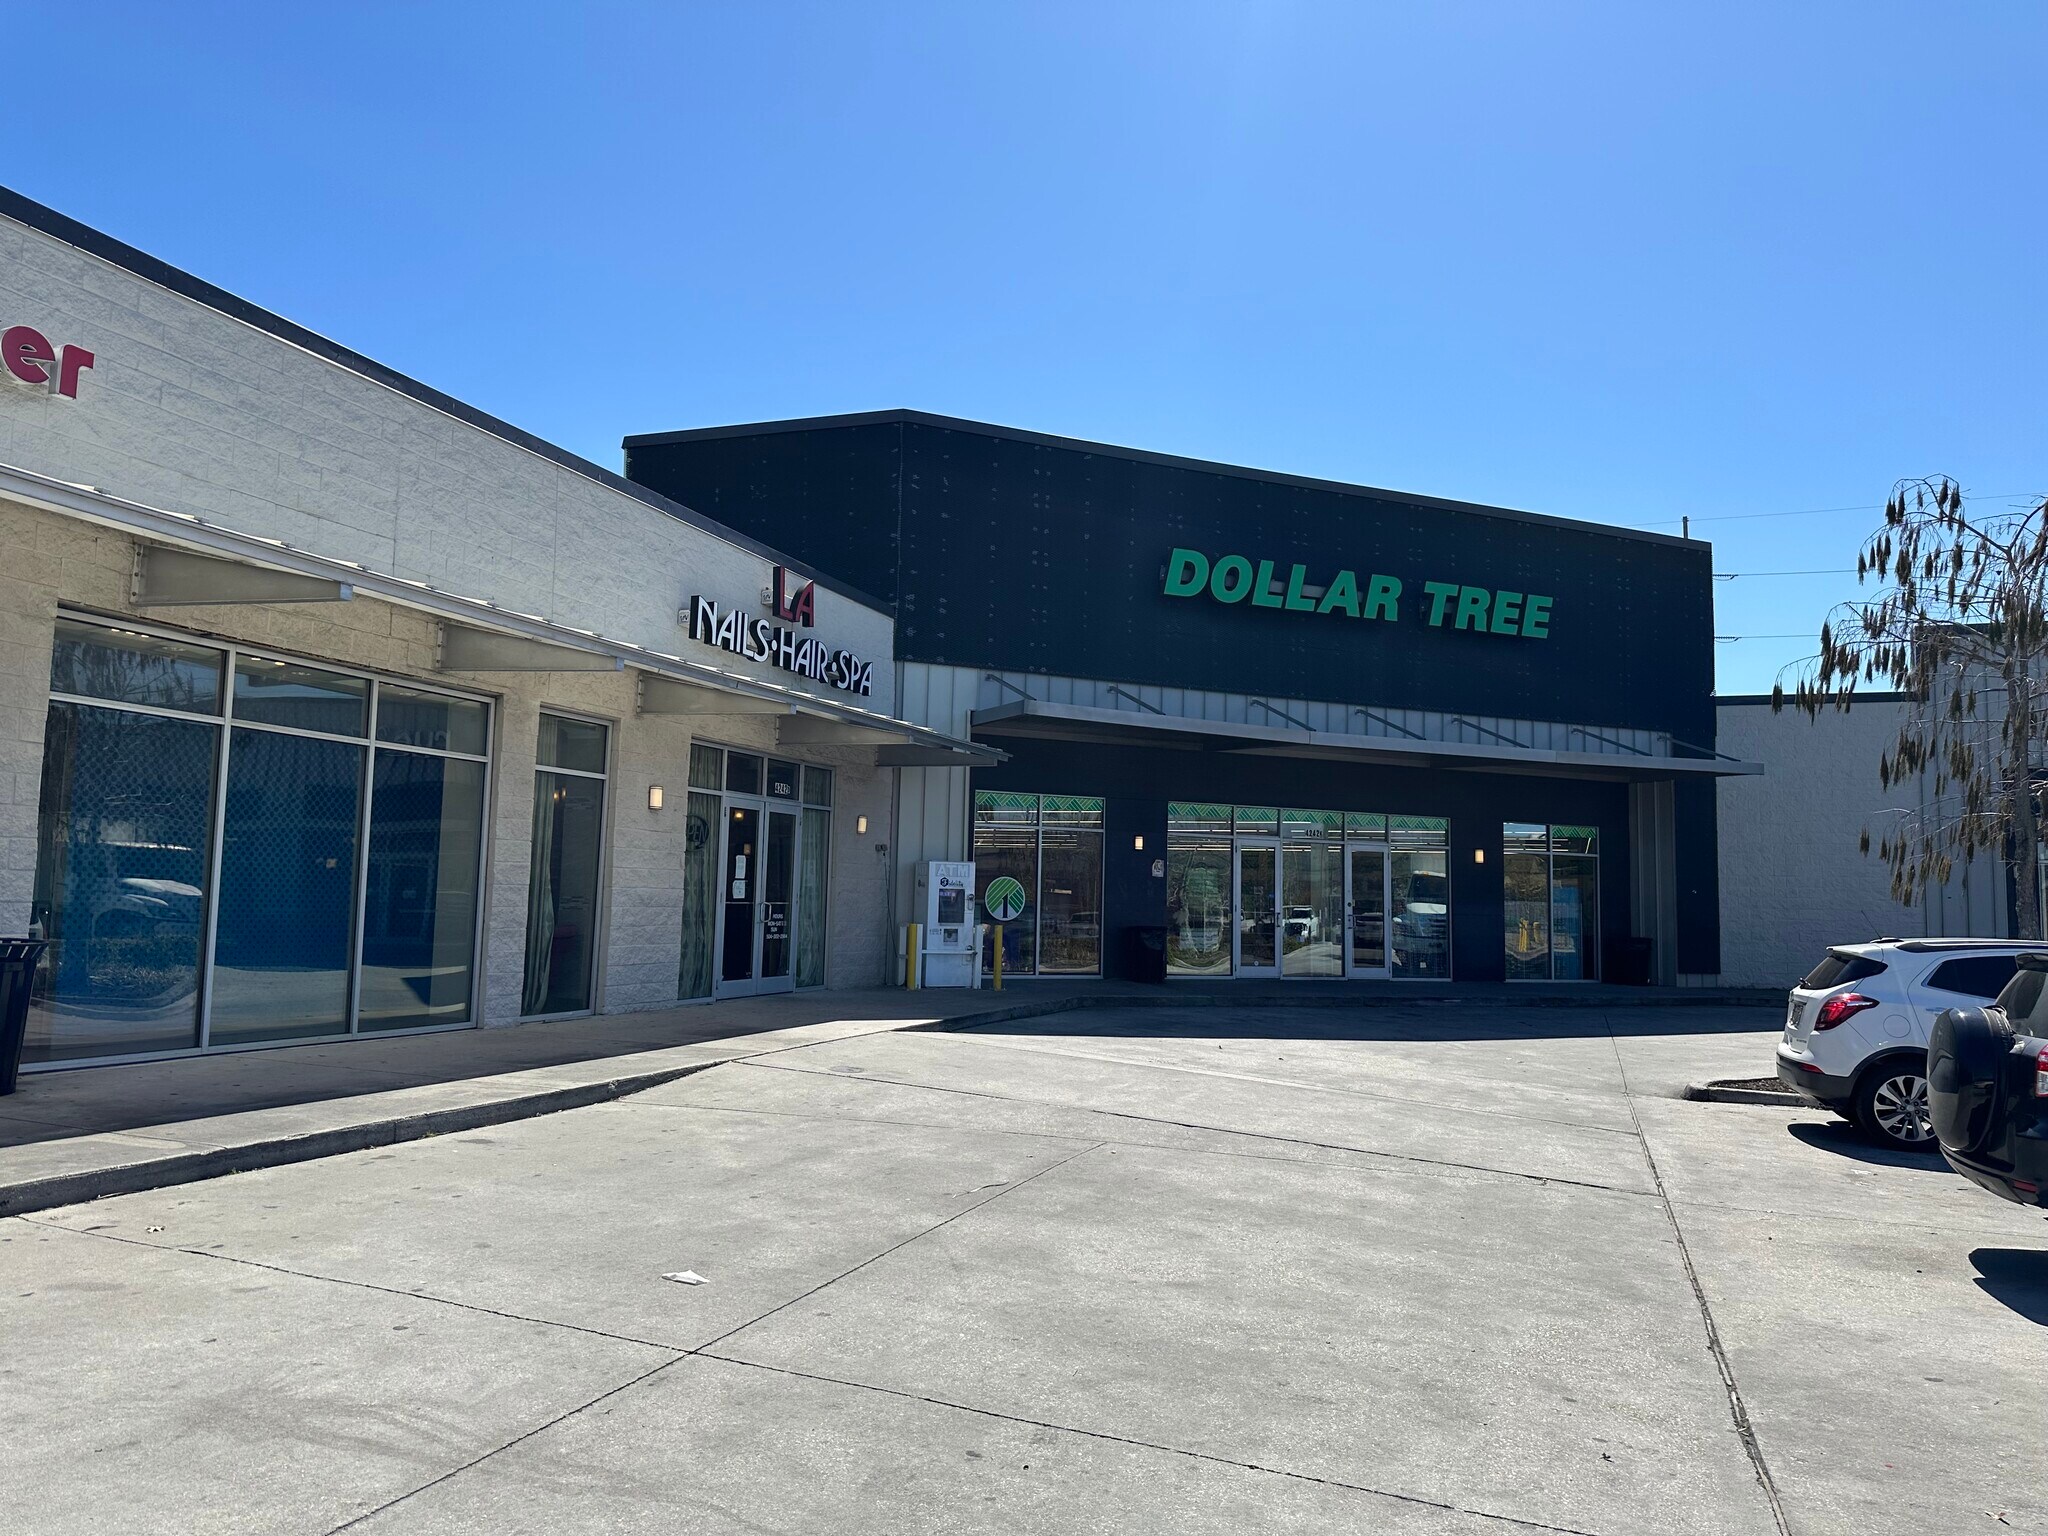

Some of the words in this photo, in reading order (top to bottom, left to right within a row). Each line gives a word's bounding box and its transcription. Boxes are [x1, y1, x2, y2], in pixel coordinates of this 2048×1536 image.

[0, 324, 96, 400] er
[774, 566, 815, 628] LA
[1164, 547, 1402, 622] DOLLAR
[1424, 581, 1553, 639] TREE
[937, 864, 969, 877] ATM
